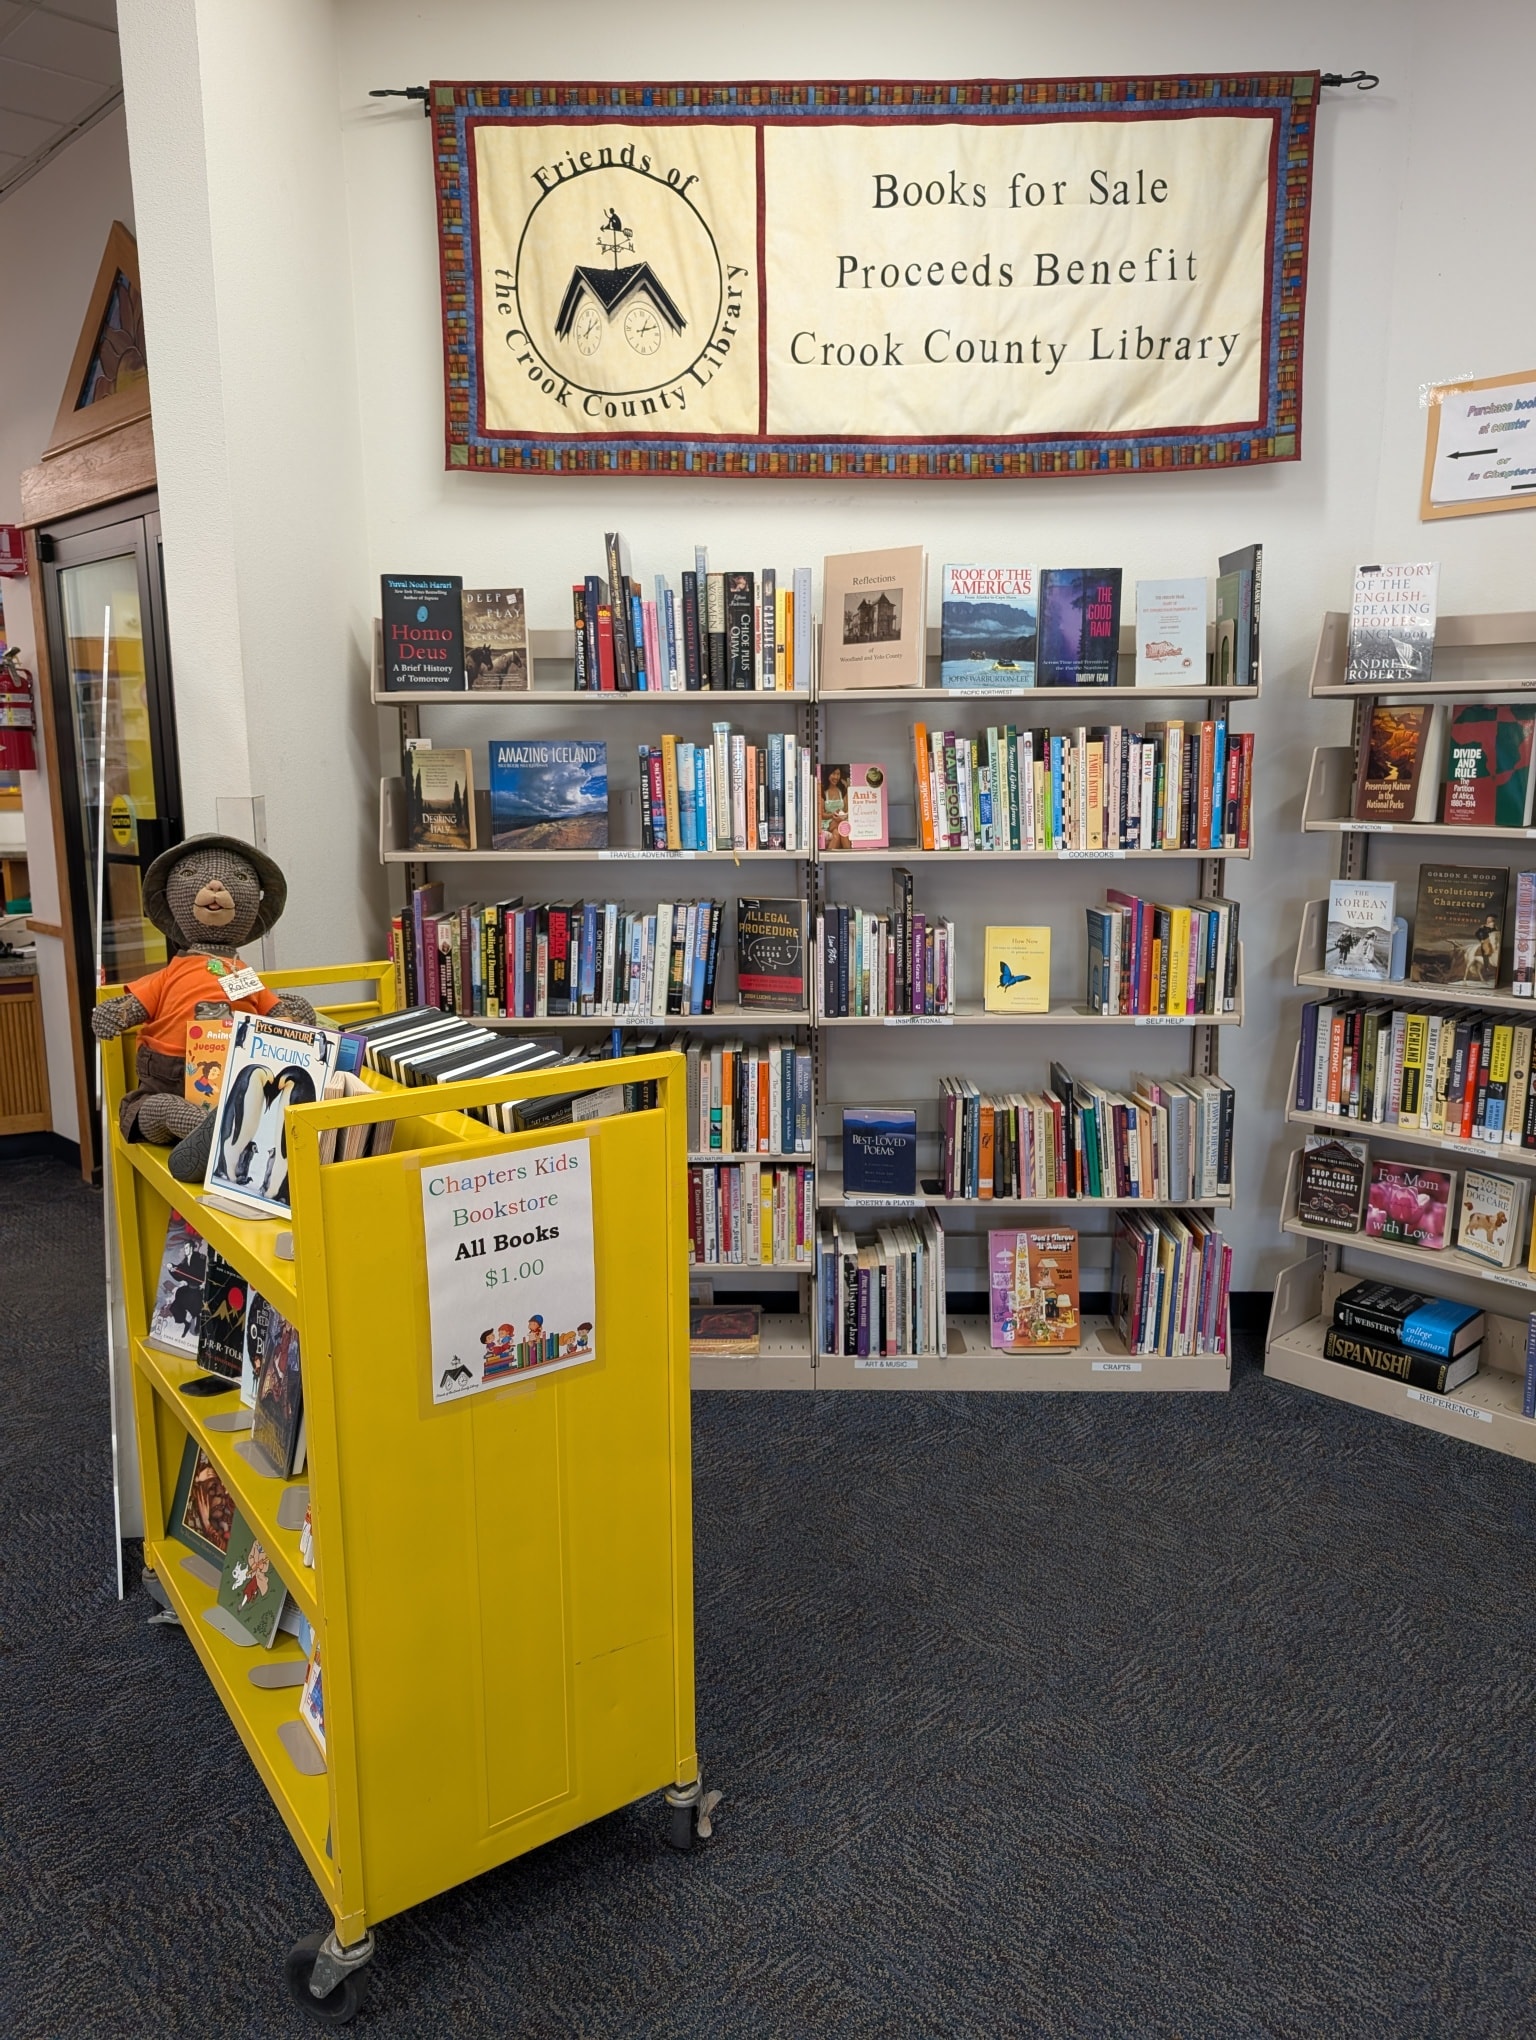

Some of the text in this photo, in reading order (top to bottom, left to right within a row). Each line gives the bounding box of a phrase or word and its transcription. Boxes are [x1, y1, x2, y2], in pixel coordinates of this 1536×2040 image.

[531, 143, 699, 196] Friends of
[871, 169, 1169, 208] Books for Sale
[835, 248, 1198, 289] Proceeds Benefit
[494, 263, 748, 418] the Crook County Library
[790, 325, 1240, 375] Crook County Library
[1467, 402, 1513, 417] Purchase
[1478, 418, 1531, 435] at counter
[852, 574, 896, 586] Reflections
[951, 568, 1032, 580] ROOF OF THE
[409, 581, 428, 589] Noah
[429, 581, 452, 589] Harari
[951, 580, 1031, 595] AMERICAS
[1356, 579, 1411, 591] OF THE
[467, 593, 501, 603] DEEP
[1097, 587, 1112, 602] THE
[1355, 591, 1428, 603] ENGLISH-
[487, 608, 521, 618] PLAY
[1088, 604, 1112, 620] GOOD
[1353, 603, 1430, 616] SPEAKING
[763, 605, 774, 649] CAPTIVE
[1090, 621, 1111, 637] RAIN
[1352, 616, 1417, 628] PEOPLES
[391, 624, 453, 641] Homo
[1352, 629, 1428, 641] SINCE 1900
[730, 626, 740, 658] OLIVIA
[741, 614, 751, 670] CHLOE PLUS
[399, 643, 448, 660] Deus
[576, 629, 586, 677] SEABISCUIT
[401, 664, 421, 672] Brief
[423, 664, 454, 674] History
[1349, 659, 1408, 669] ANDRE
[396, 674, 450, 683] of Tomorrow
[1349, 669, 1413, 680] ROBERTS
[498, 747, 597, 763] AMAZING ICELAND
[1453, 748, 1482, 759] DIVIDE
[1144, 747, 1152, 783] THRIVE
[1457, 759, 1475, 768] AND
[990, 752, 999, 802] RAWMAZING
[1088, 754, 1098, 808] FAMILY KITCHEN
[1454, 768, 1477, 778] RULE
[1460, 777, 1469, 785] The
[641, 775, 649, 799] FROZEN
[946, 747, 960, 827] RAW FOOD
[1365, 782, 1411, 792] Preserving Nature
[853, 791, 877, 800] Ani's
[1378, 791, 1394, 800] in the
[1459, 792, 1475, 800] Africa,
[1366, 800, 1405, 809] National Parks
[1427, 886, 1494, 898] Revolutionary
[1335, 898, 1388, 909] KOREAN
[1433, 898, 1486, 908] Characters
[747, 911, 790, 924] ILLEGAL
[1347, 910, 1374, 920] WAR
[556, 912, 566, 960] HOCKEY
[596, 930, 602, 939] ON
[739, 924, 799, 937] PROCEDURE
[487, 928, 496, 995] Sailing Dummies
[255, 1019, 315, 1046] EYES ON NATURE
[193, 1042, 226, 1053] Juegos
[1407, 1022, 1421, 1063] KOCHLAND
[250, 1036, 311, 1067] PENGUINS
[1425, 1029, 1438, 1088] BABYLON BY BUS
[1392, 1030, 1405, 1113] THE DYING CITIZEN
[852, 1135, 906, 1146] BEST-LOVED
[863, 1145, 894, 1156] POEMS
[1453, 1144, 1486, 1155] NONFICTION
[428, 1153, 579, 1197] Chapters Kids
[1332, 1172, 1355, 1182] CLASS
[1378, 1169, 1439, 1191] For Mom
[1318, 1179, 1358, 1192] SOULCRAFT
[1466, 1190, 1508, 1211] DOG CARE
[453, 1193, 559, 1227] Bookstore
[1373, 1220, 1434, 1241] with Love
[454, 1224, 560, 1261] All Books
[485, 1258, 545, 1289] $1.00
[1494, 1275, 1528, 1287] NONFICTION
[849, 1284, 858, 1317] History
[1354, 1316, 1433, 1340] WEBSTER'S college
[849, 1327, 857, 1347] Jazz
[1406, 1335, 1446, 1353] dictionary
[224, 1345, 243, 1361] TOLK
[1334, 1338, 1404, 1376] SPANISH
[1436, 1365, 1446, 1390] OXFORD
[1419, 1393, 1480, 1419] REFERENCE
